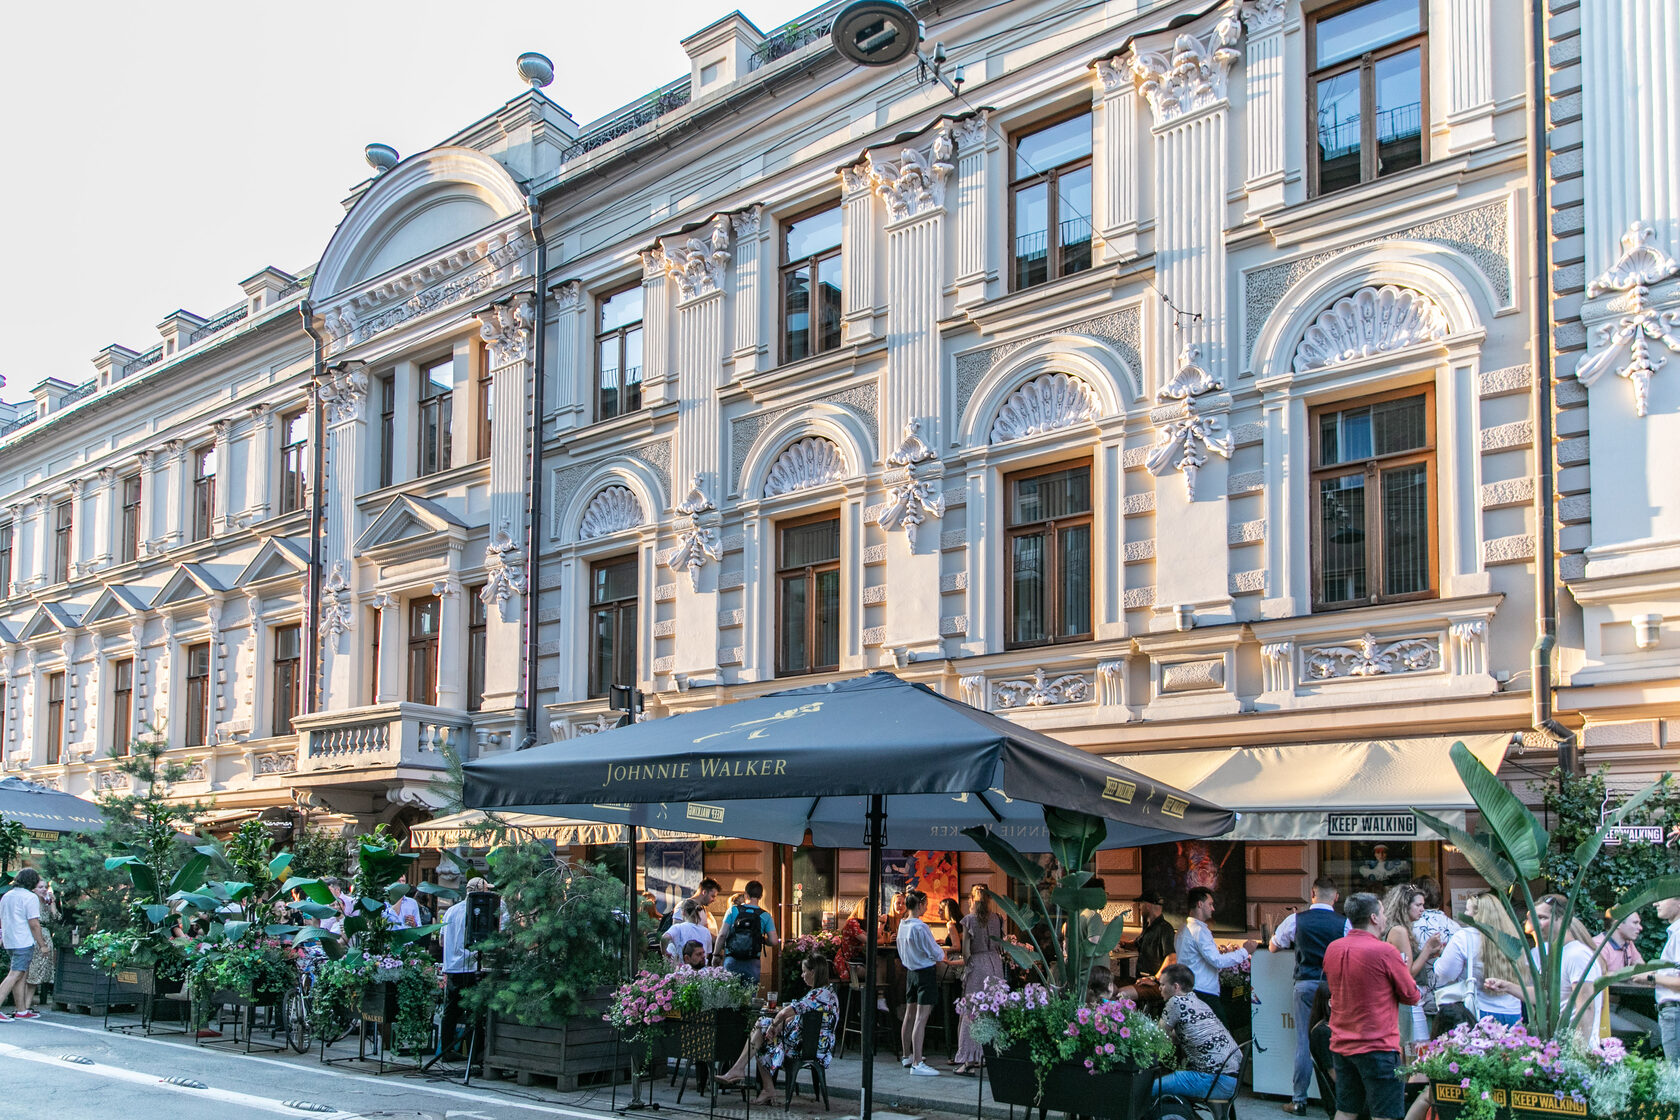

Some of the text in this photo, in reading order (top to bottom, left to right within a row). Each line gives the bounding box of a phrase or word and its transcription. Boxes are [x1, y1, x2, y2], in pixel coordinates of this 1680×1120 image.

[602, 758, 787, 786] JOHNNIE WALKER
[1331, 816, 1413, 832] KEEP WALKING
[1281, 1013, 1296, 1029] Th
[1439, 1086, 1462, 1099] KEEP
[1514, 1093, 1538, 1107] KEEP
